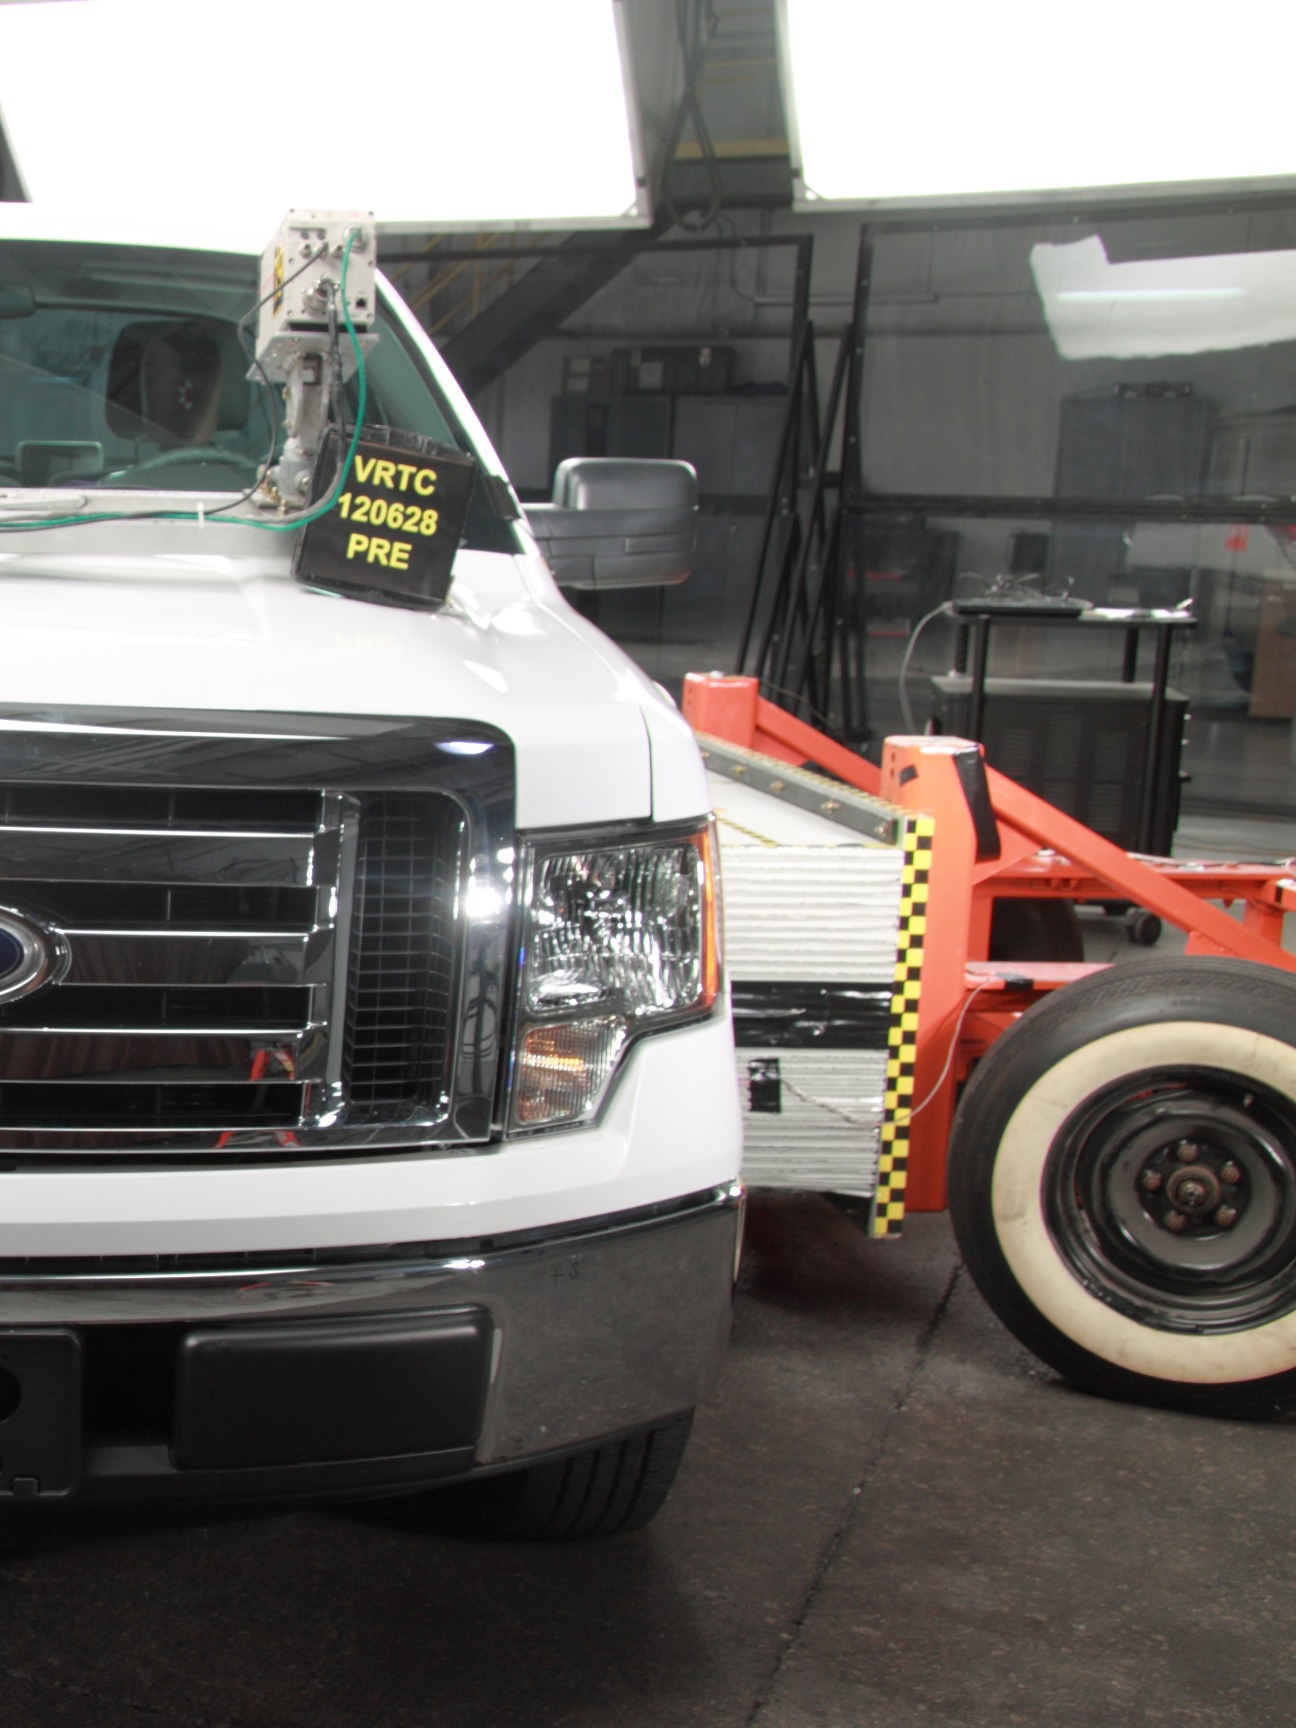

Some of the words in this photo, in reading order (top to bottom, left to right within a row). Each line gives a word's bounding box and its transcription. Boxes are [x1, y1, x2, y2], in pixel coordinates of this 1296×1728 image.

[354, 455, 437, 496] VRTC
[338, 492, 439, 536] 120628
[346, 533, 413, 570] PRE
